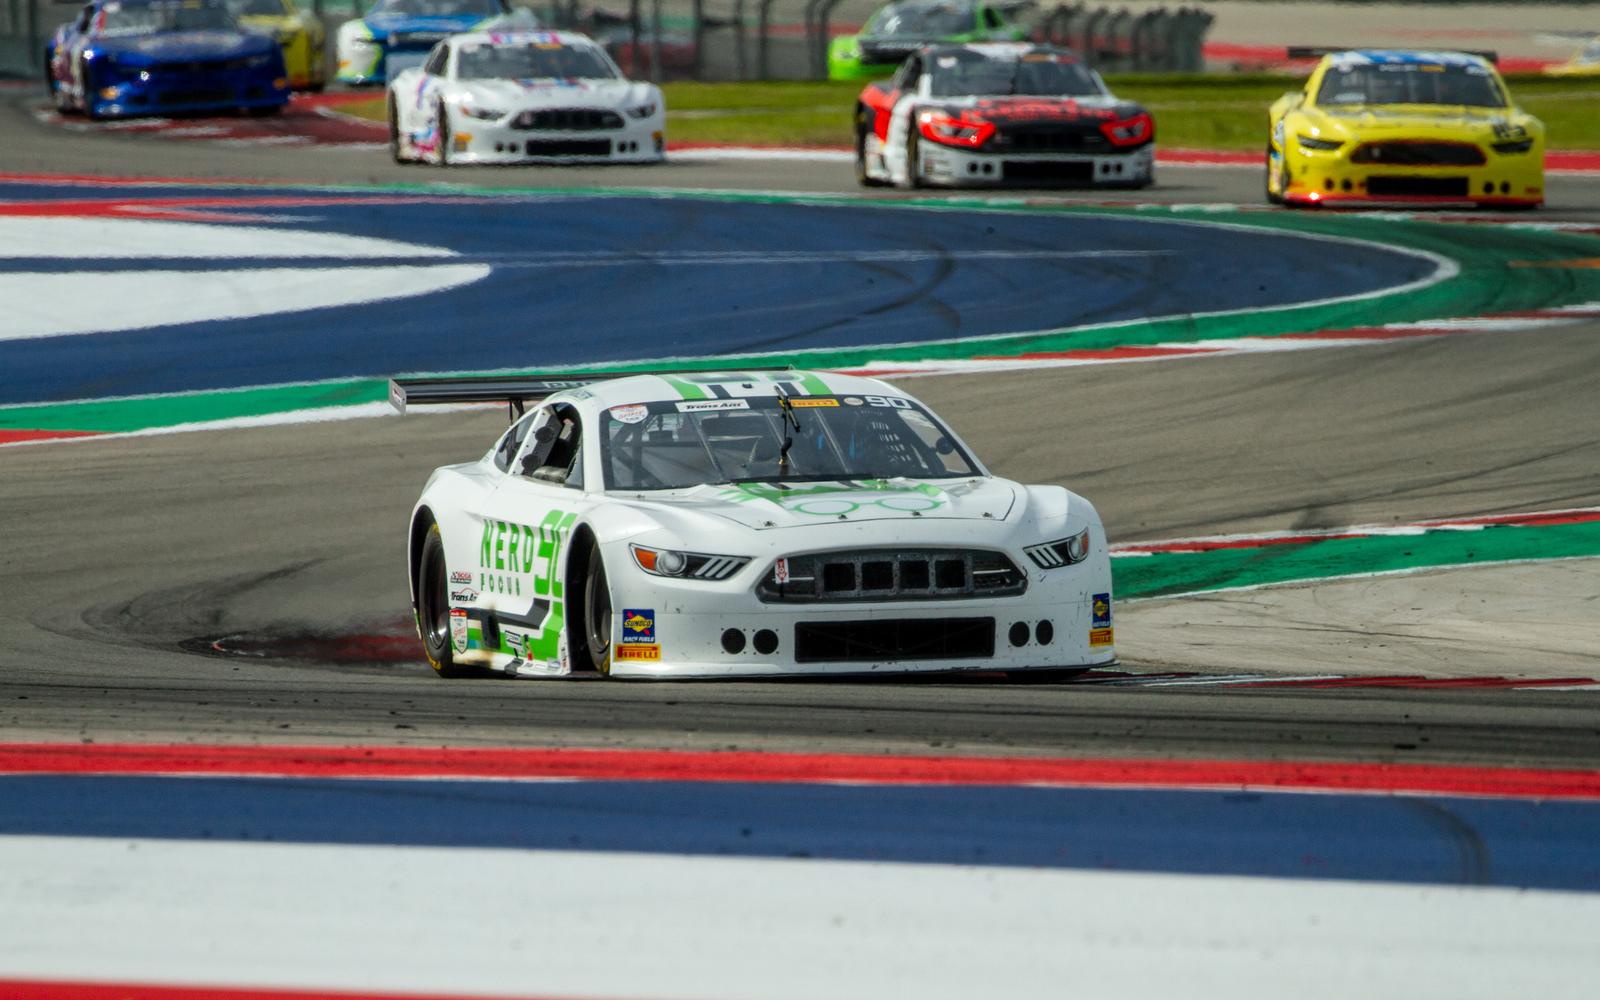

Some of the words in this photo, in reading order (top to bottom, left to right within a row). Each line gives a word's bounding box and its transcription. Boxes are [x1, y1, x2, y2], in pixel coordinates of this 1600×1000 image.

[865, 396, 913, 409] 90
[480, 519, 535, 573] NERD
[480, 573, 520, 596] FOCUS
[617, 646, 658, 658] PIRELLI
